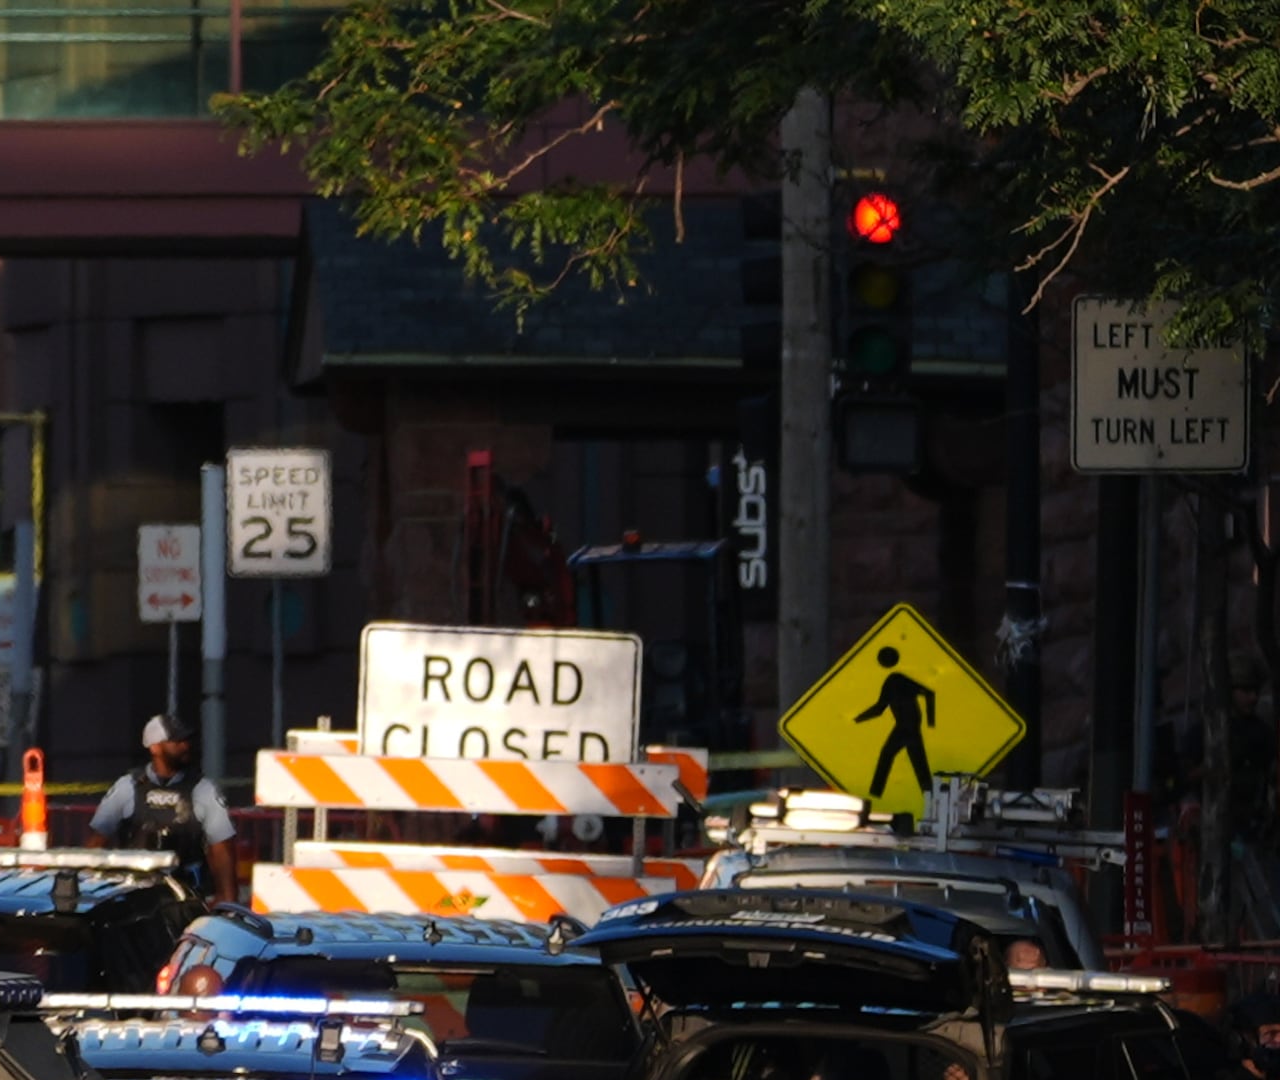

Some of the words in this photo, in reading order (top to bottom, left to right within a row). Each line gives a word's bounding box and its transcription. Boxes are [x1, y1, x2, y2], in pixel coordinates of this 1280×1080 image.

[1093, 322, 1153, 349] LEFT
[1117, 366, 1199, 400] MUST
[1091, 417, 1155, 444] TURN
[1170, 417, 1229, 444] LEFT
[239, 467, 320, 486] SPEED
[246, 491, 309, 511] LIMIT
[241, 516, 317, 559] 25
[422, 655, 583, 706] ROAD
